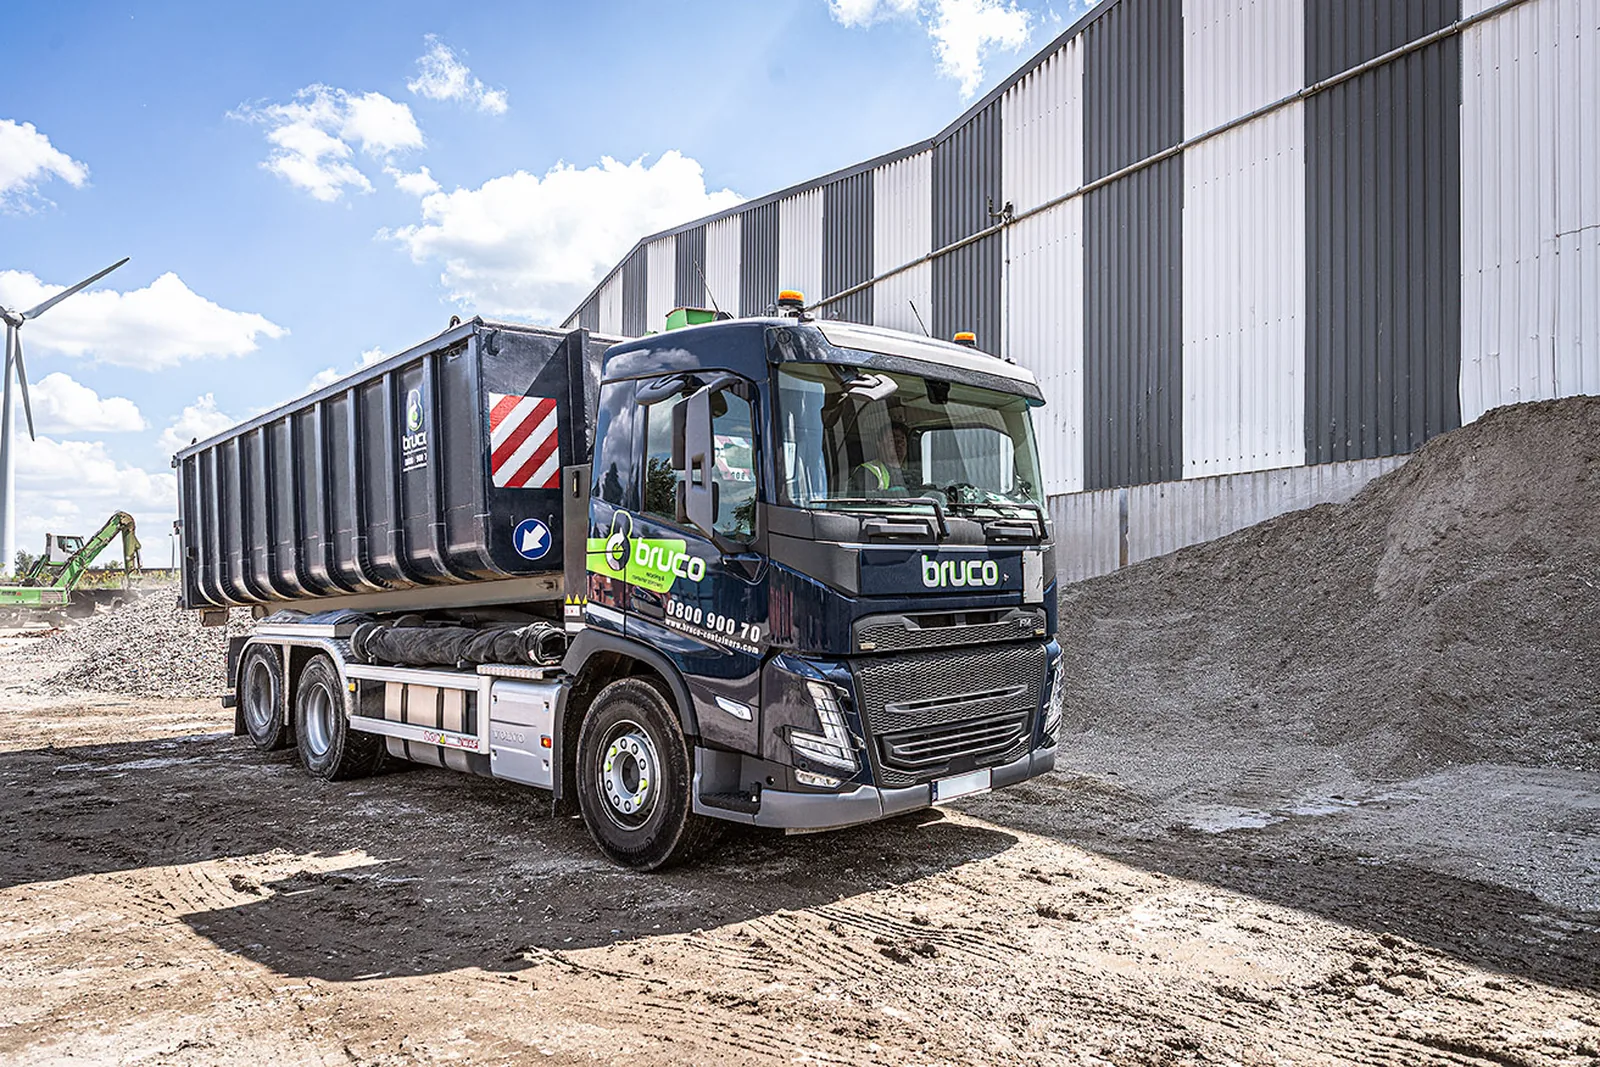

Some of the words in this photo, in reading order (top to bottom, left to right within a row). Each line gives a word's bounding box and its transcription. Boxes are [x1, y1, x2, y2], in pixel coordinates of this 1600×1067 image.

[635, 537, 706, 582] bruco
[921, 555, 999, 588] bruco
[664, 618, 759, 655] www.bruco-containers.com
[666, 599, 703, 625] 0800
[706, 612, 736, 636] 900
[740, 621, 760, 643] 70
